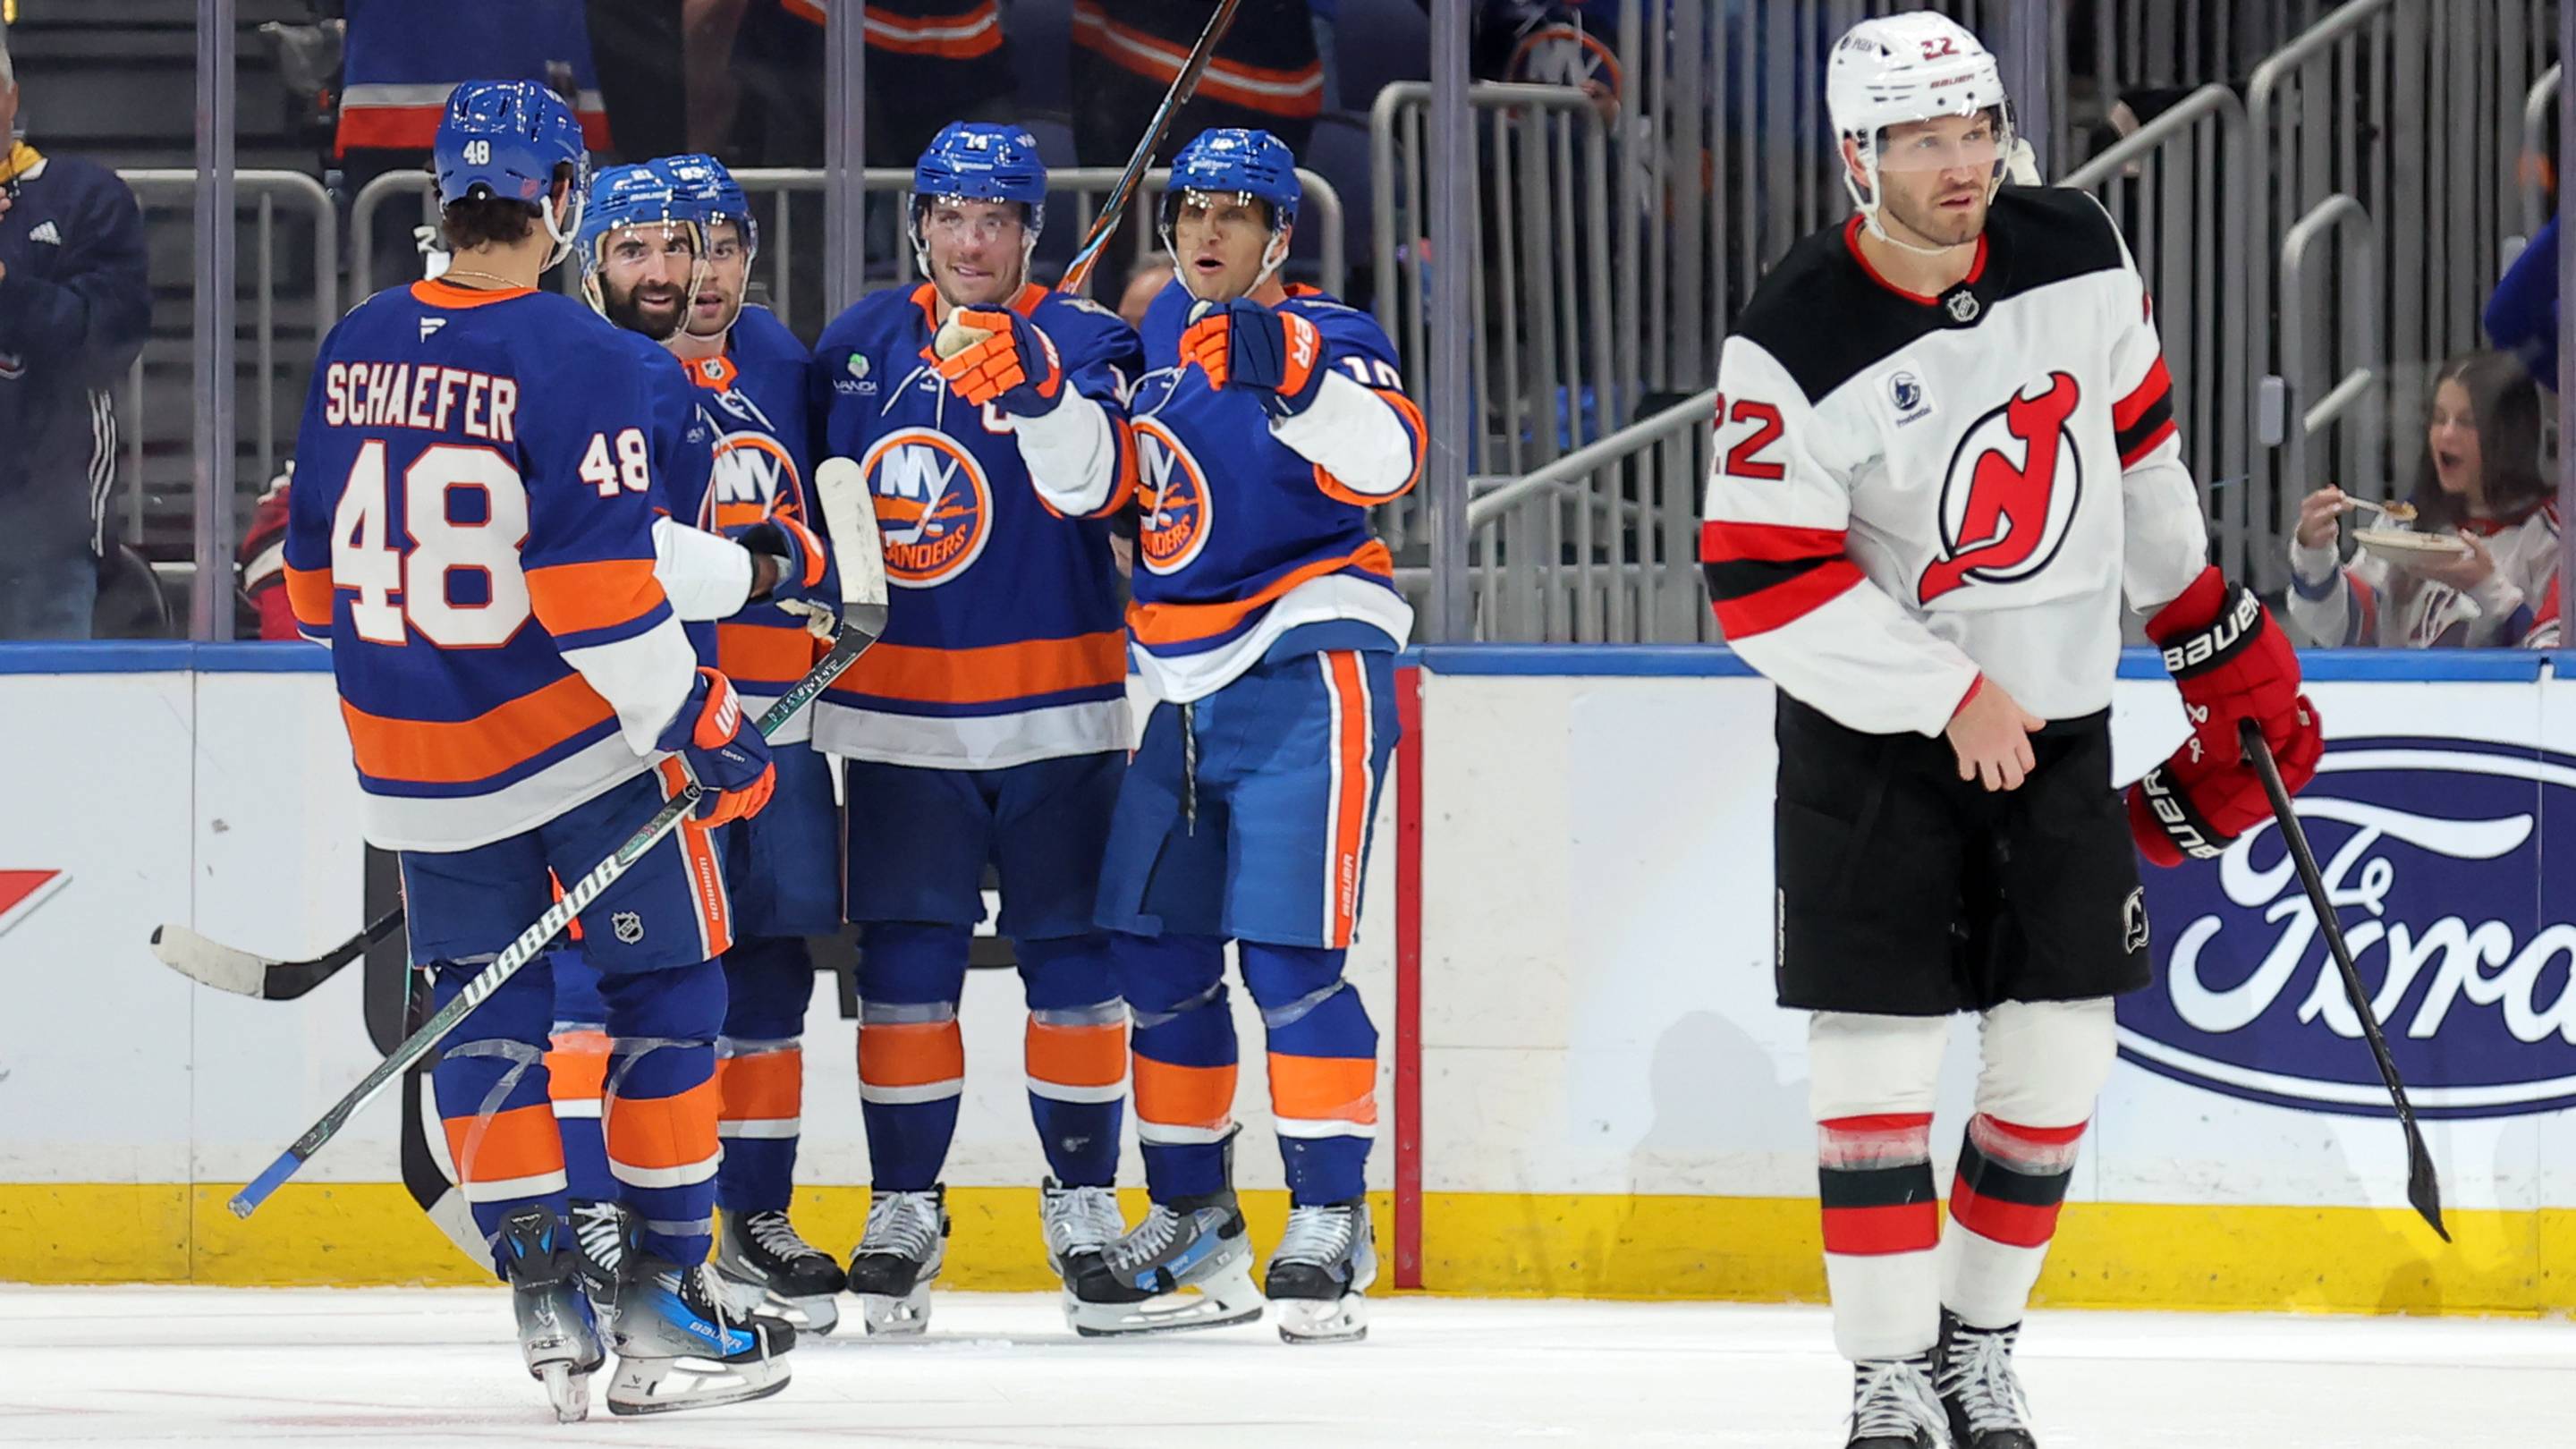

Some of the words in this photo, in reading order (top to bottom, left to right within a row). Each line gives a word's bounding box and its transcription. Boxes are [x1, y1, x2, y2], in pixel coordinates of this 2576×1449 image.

[462, 140, 490, 165] 48
[325, 361, 519, 443] SCHAEFER
[578, 428, 651, 498] 48
[331, 438, 532, 650] 48
[885, 523, 967, 570] ANDERS
[2163, 587, 2260, 672] BAUER
[2143, 768, 2224, 860] AUER
[698, 856, 719, 922] WARRIOR
[1343, 853, 1353, 917] BAUER
[462, 854, 626, 1007] WARRIOR
[689, 1321, 743, 1350] BAUR
